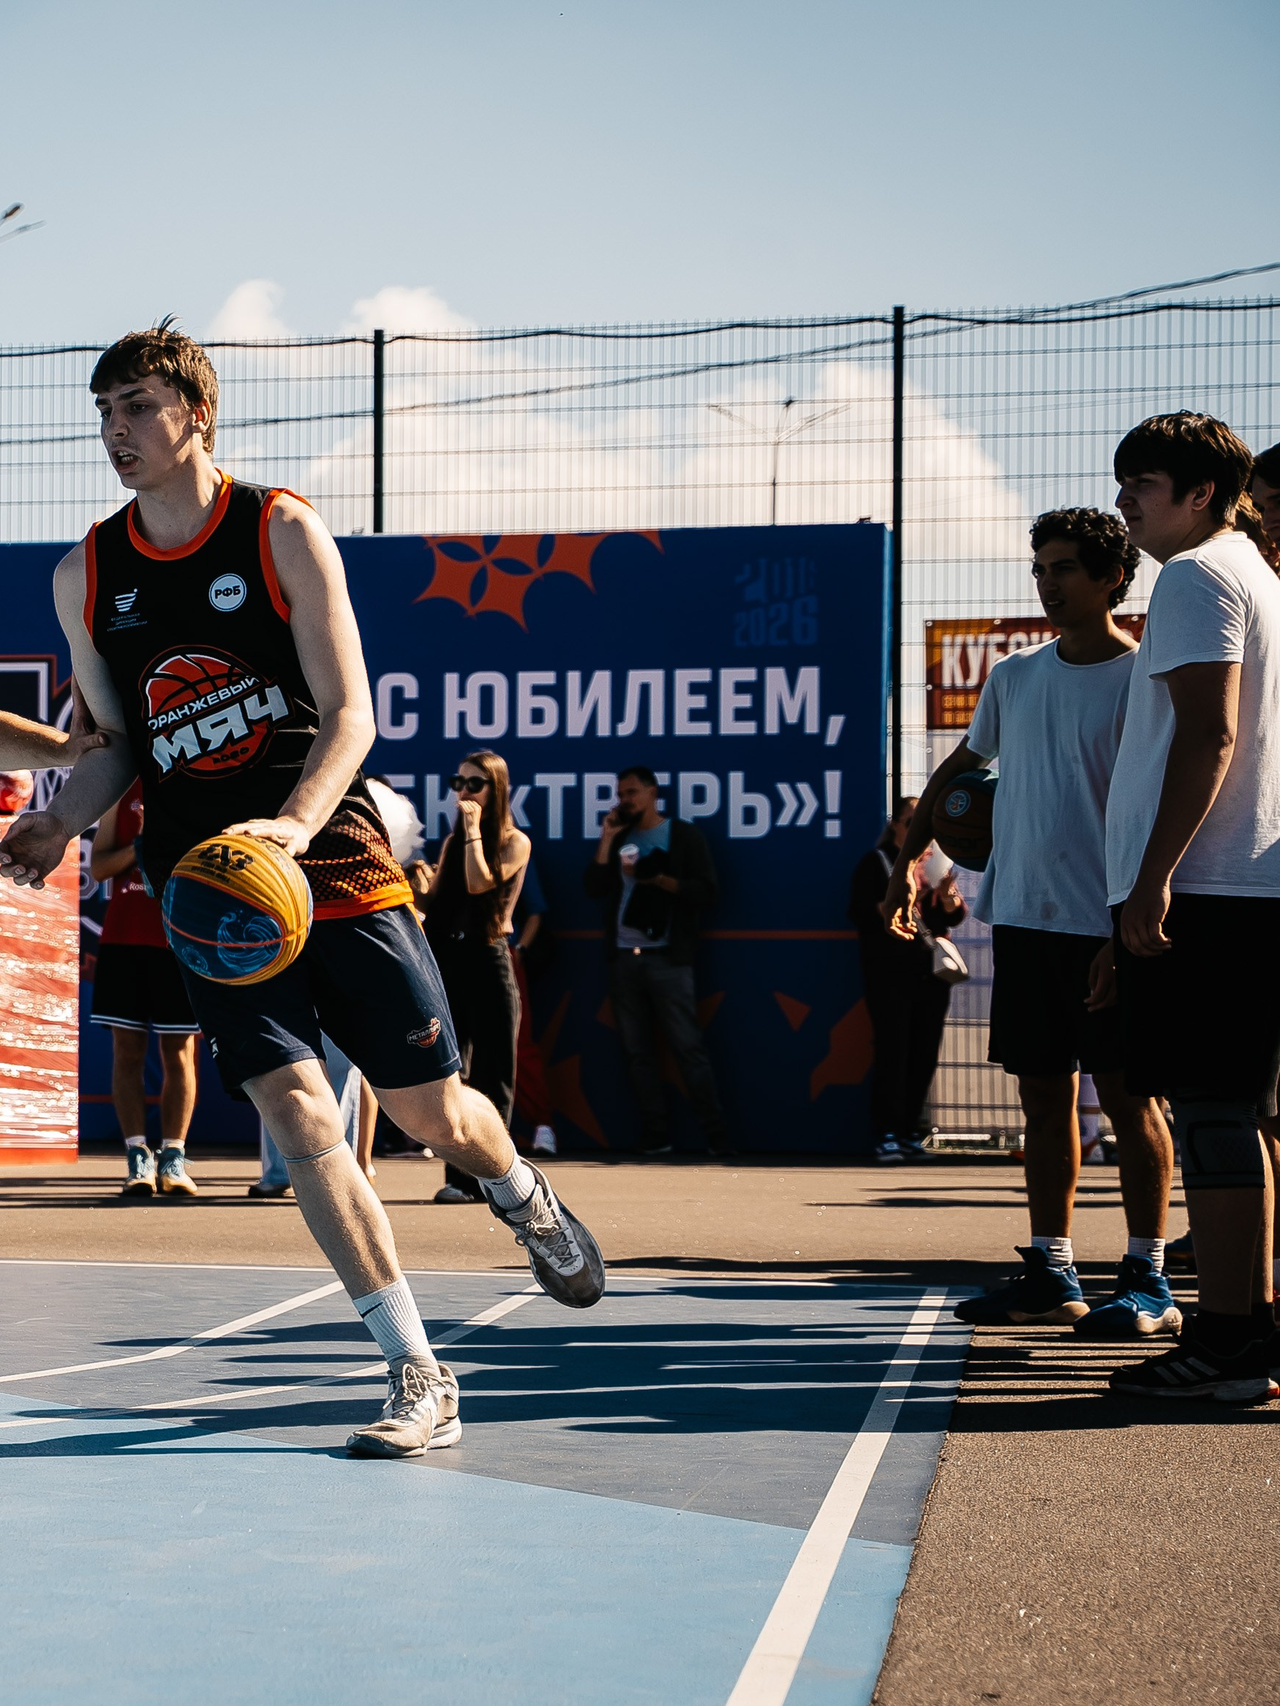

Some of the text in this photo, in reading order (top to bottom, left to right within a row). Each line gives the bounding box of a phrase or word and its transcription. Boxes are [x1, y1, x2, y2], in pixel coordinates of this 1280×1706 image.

[214, 585, 242, 600] РФБ
[734, 595, 819, 647] 2026
[152, 684, 289, 774] МЯЧ
[376, 666, 846, 746] С ЮБИЛЕЕМ,
[509, 769, 843, 840] «ТВРЬ»!
